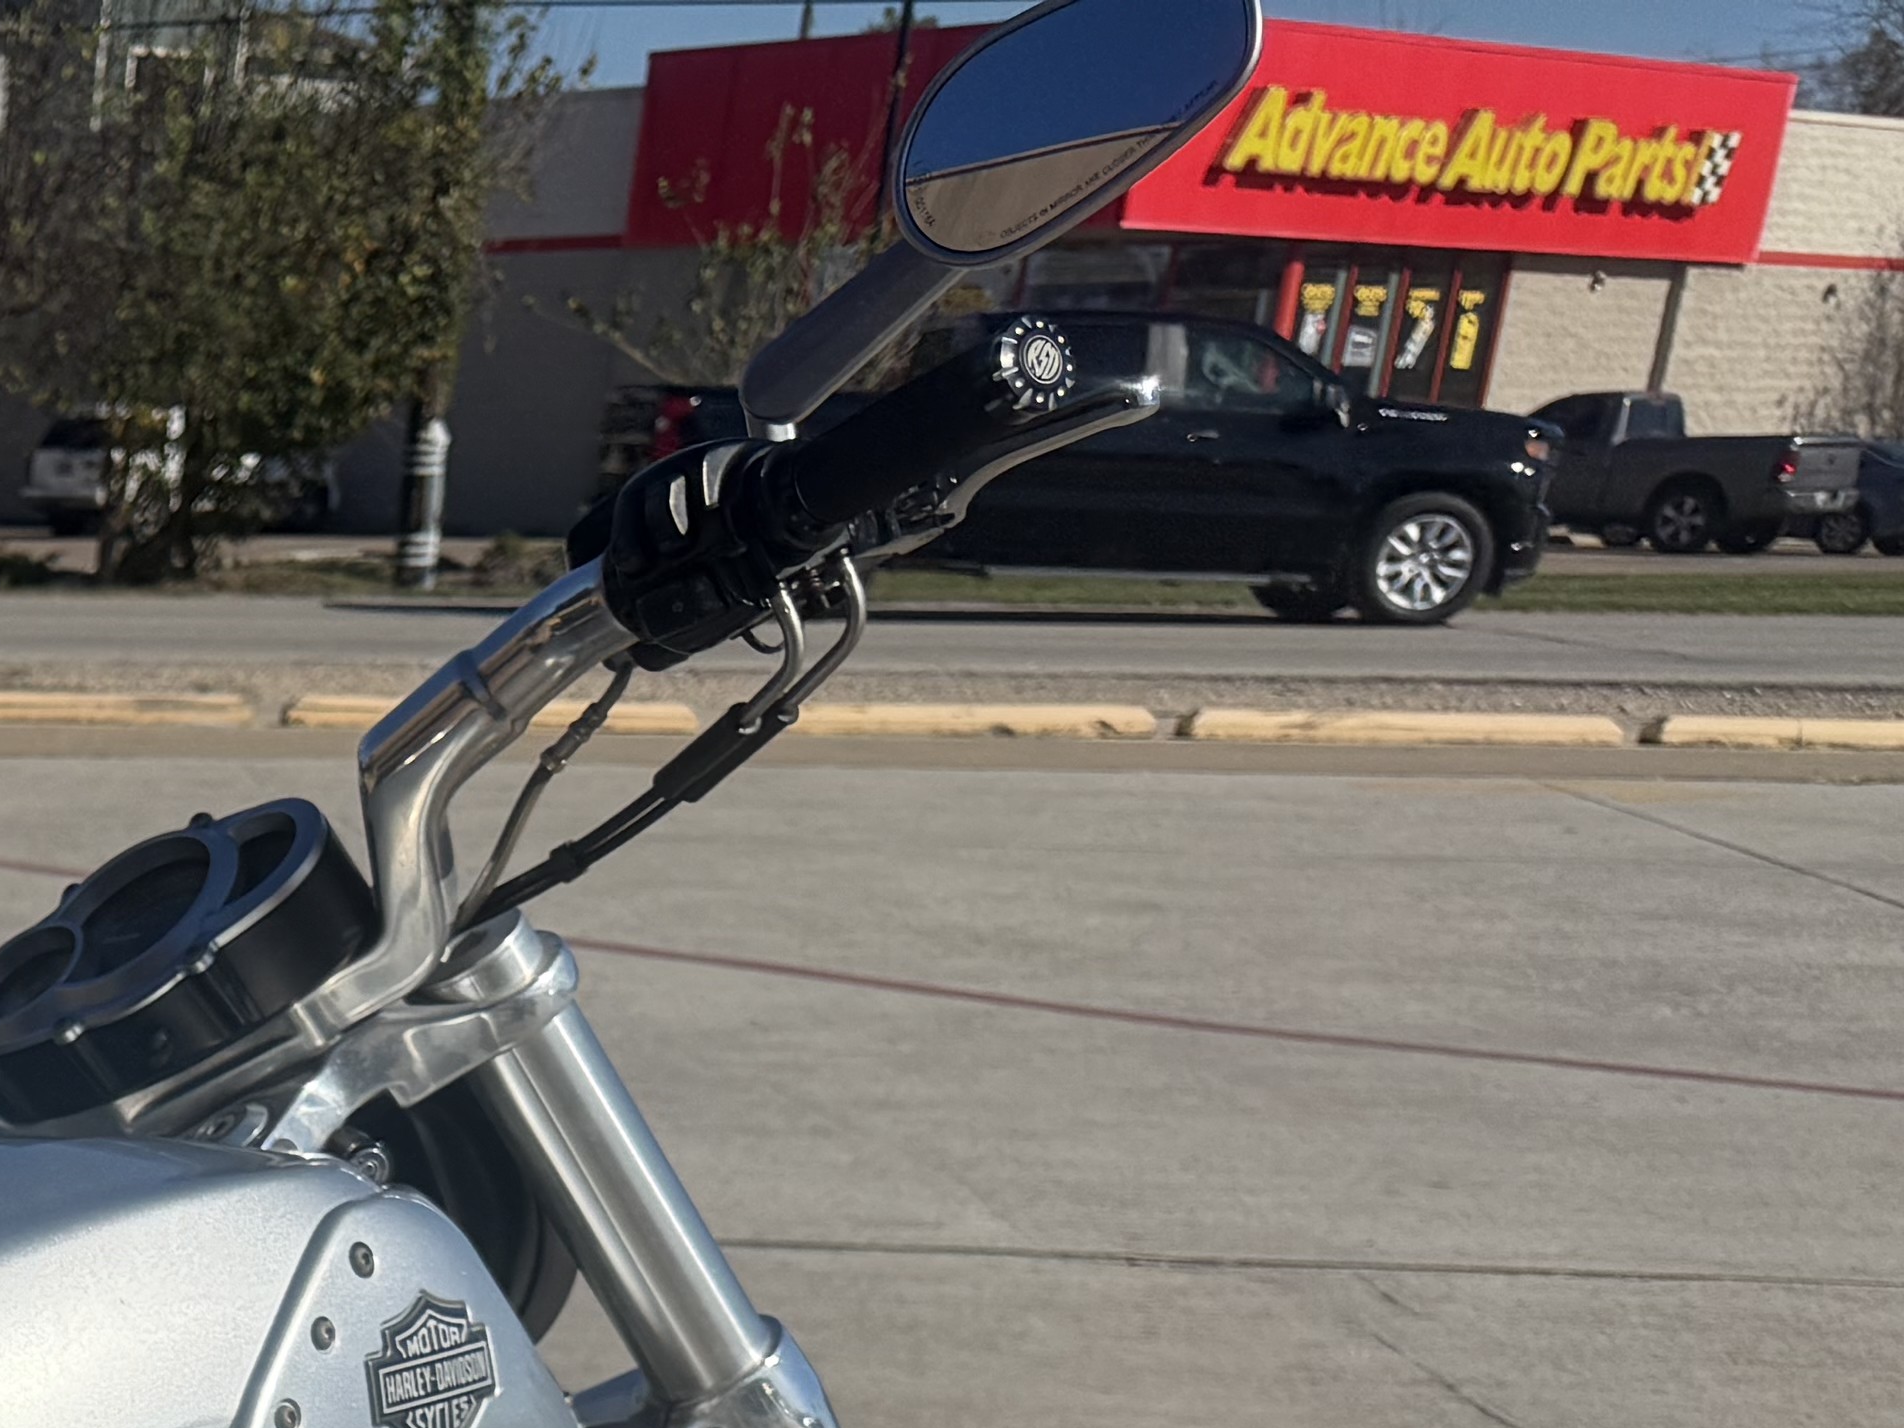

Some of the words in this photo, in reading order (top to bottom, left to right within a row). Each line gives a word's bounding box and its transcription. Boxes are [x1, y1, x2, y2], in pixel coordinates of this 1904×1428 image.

[1224, 85, 1449, 183] Advance
[1436, 107, 1574, 195] Auto
[1559, 117, 1700, 204] Parts
[1049, 184, 1085, 213] MIRROR
[406, 1319, 461, 1358] MOTOR
[385, 1350, 488, 1404] HARLEY-DAVIDSON
